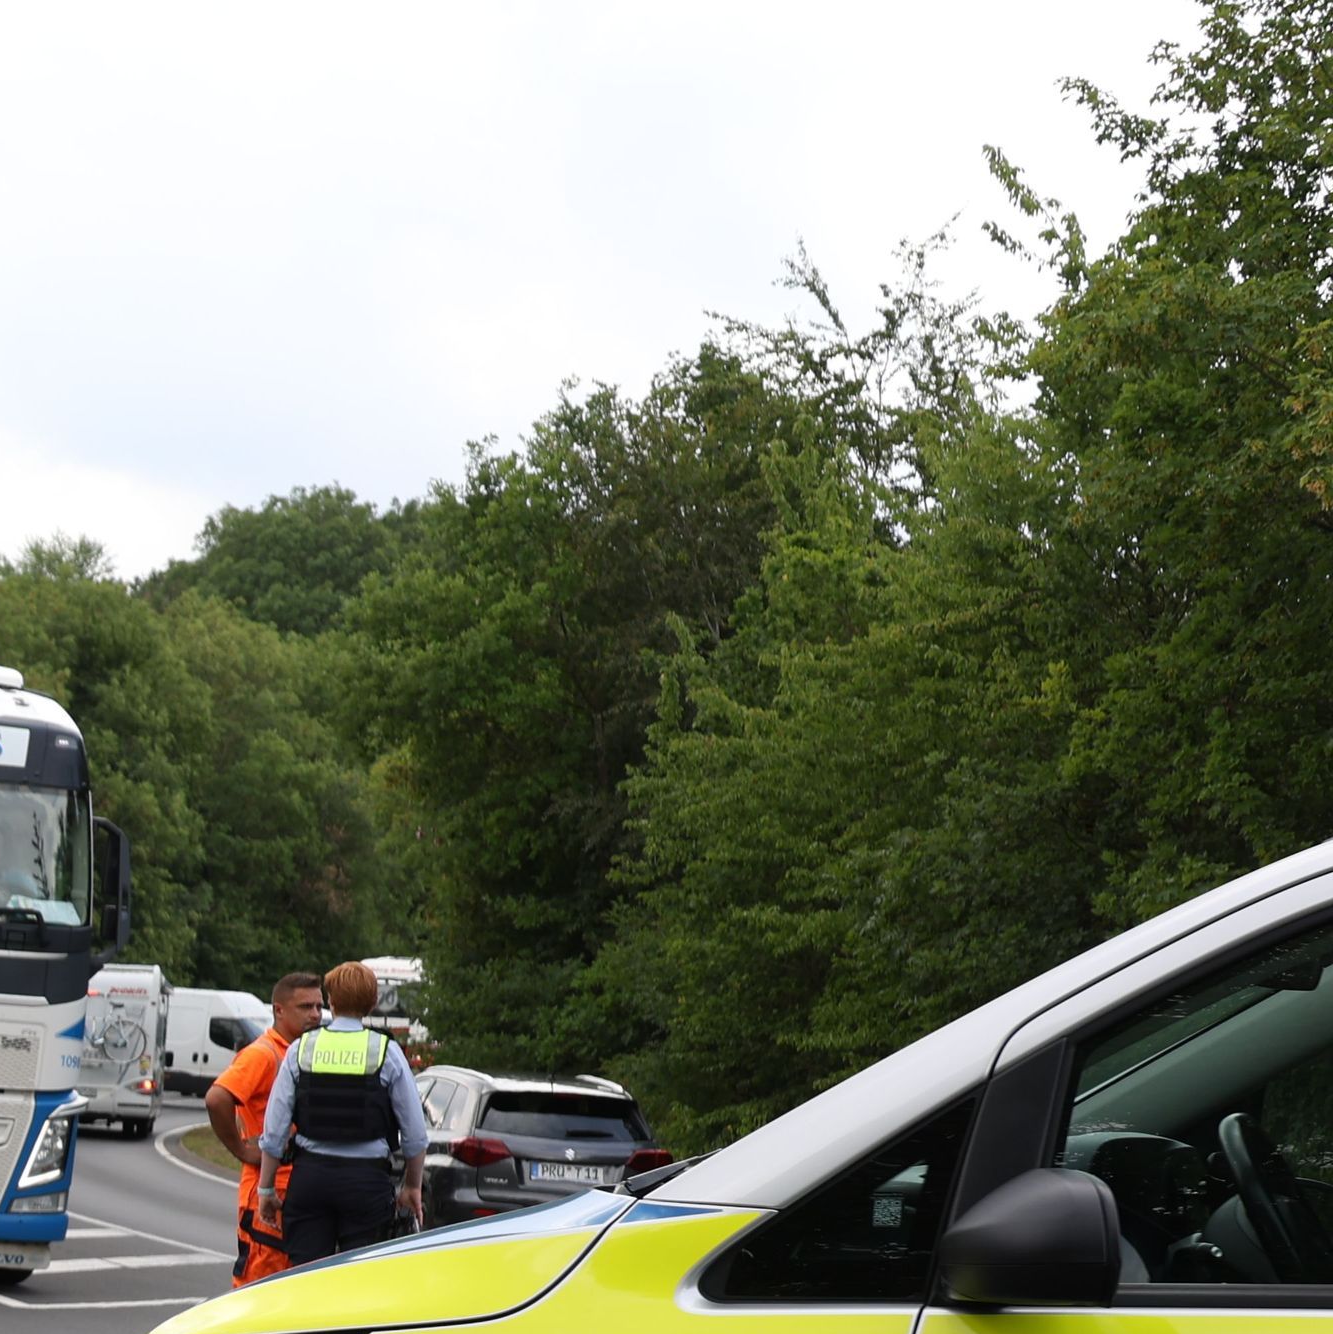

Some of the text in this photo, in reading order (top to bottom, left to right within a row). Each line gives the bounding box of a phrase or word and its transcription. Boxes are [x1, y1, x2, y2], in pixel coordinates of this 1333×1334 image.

[314, 1050, 364, 1066] POLIZEI
[574, 1167, 582, 1179] T
[585, 1168, 599, 1180] 11
